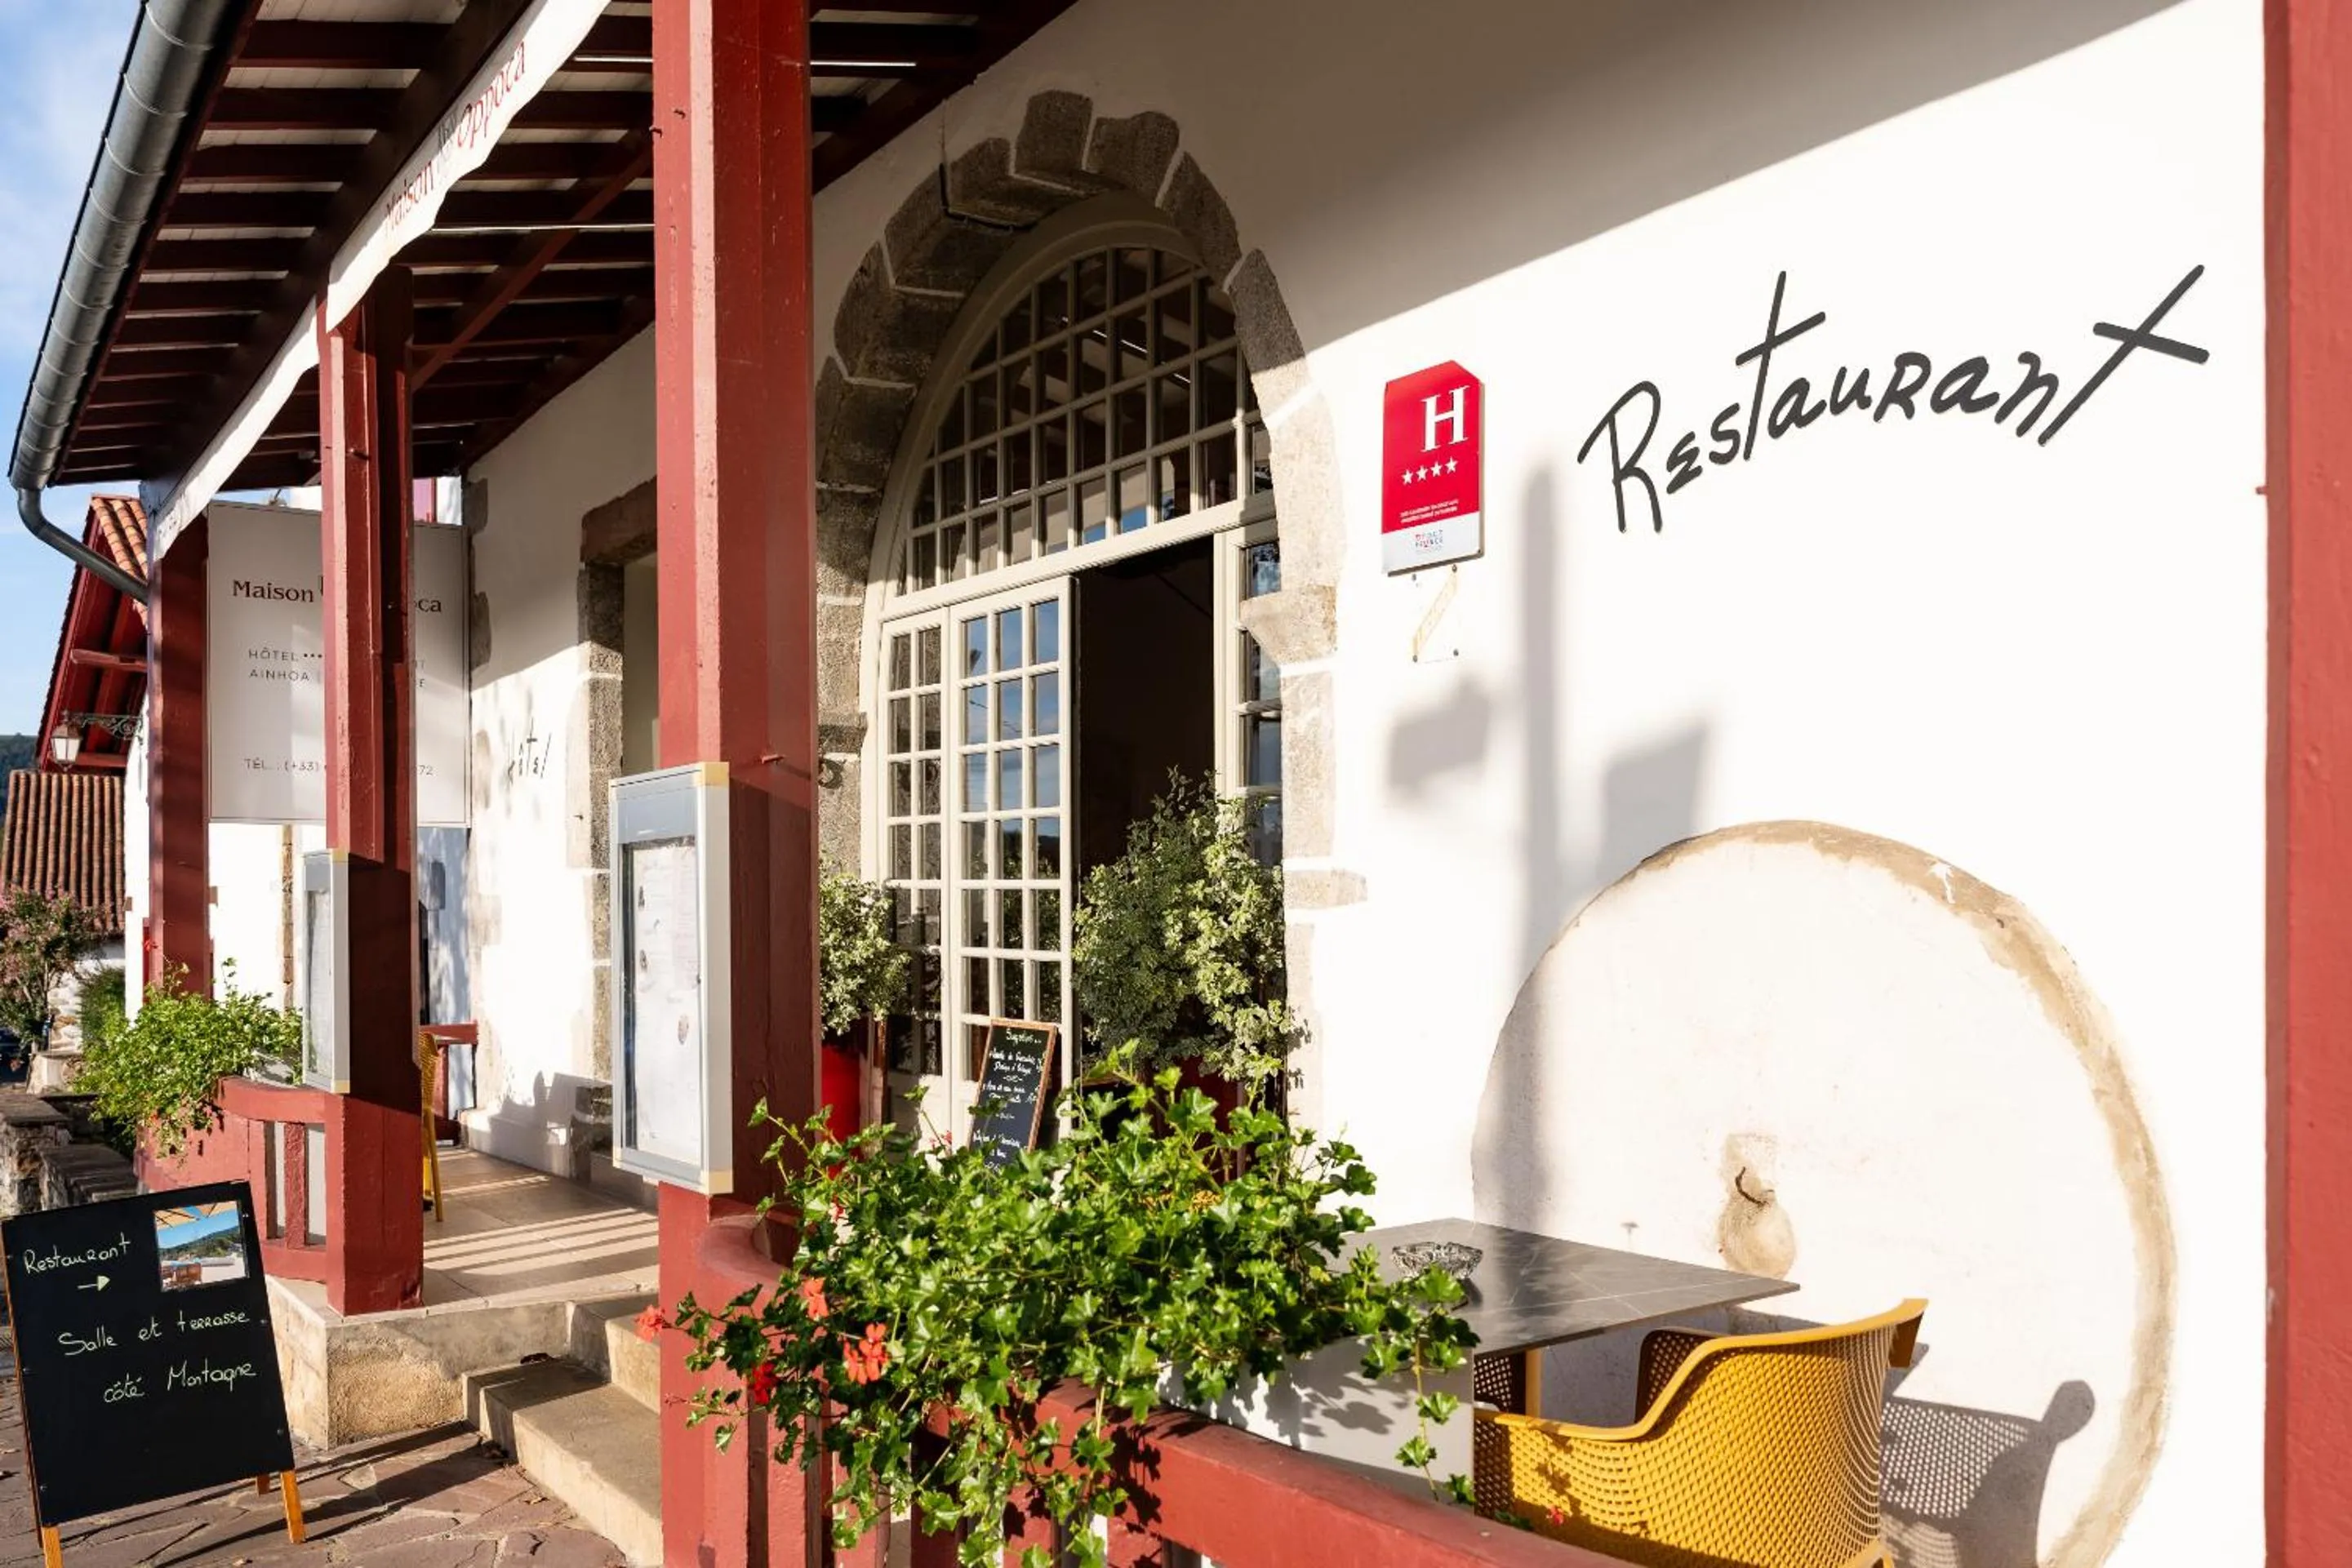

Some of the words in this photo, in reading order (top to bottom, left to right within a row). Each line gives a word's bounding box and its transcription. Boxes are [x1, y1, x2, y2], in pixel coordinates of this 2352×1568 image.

[1421, 384, 1470, 453] H
[1577, 264, 2210, 533] Restaurant
[233, 579, 314, 603] Maison
[248, 646, 299, 662] HÔTEL
[249, 669, 310, 682] AINHOA
[23, 1231, 131, 1274] Restaurant
[58, 1325, 118, 1356] Salle
[138, 1316, 162, 1341] et
[176, 1309, 250, 1332] terrasse
[103, 1373, 145, 1403] côté
[167, 1358, 257, 1393] Montagne
